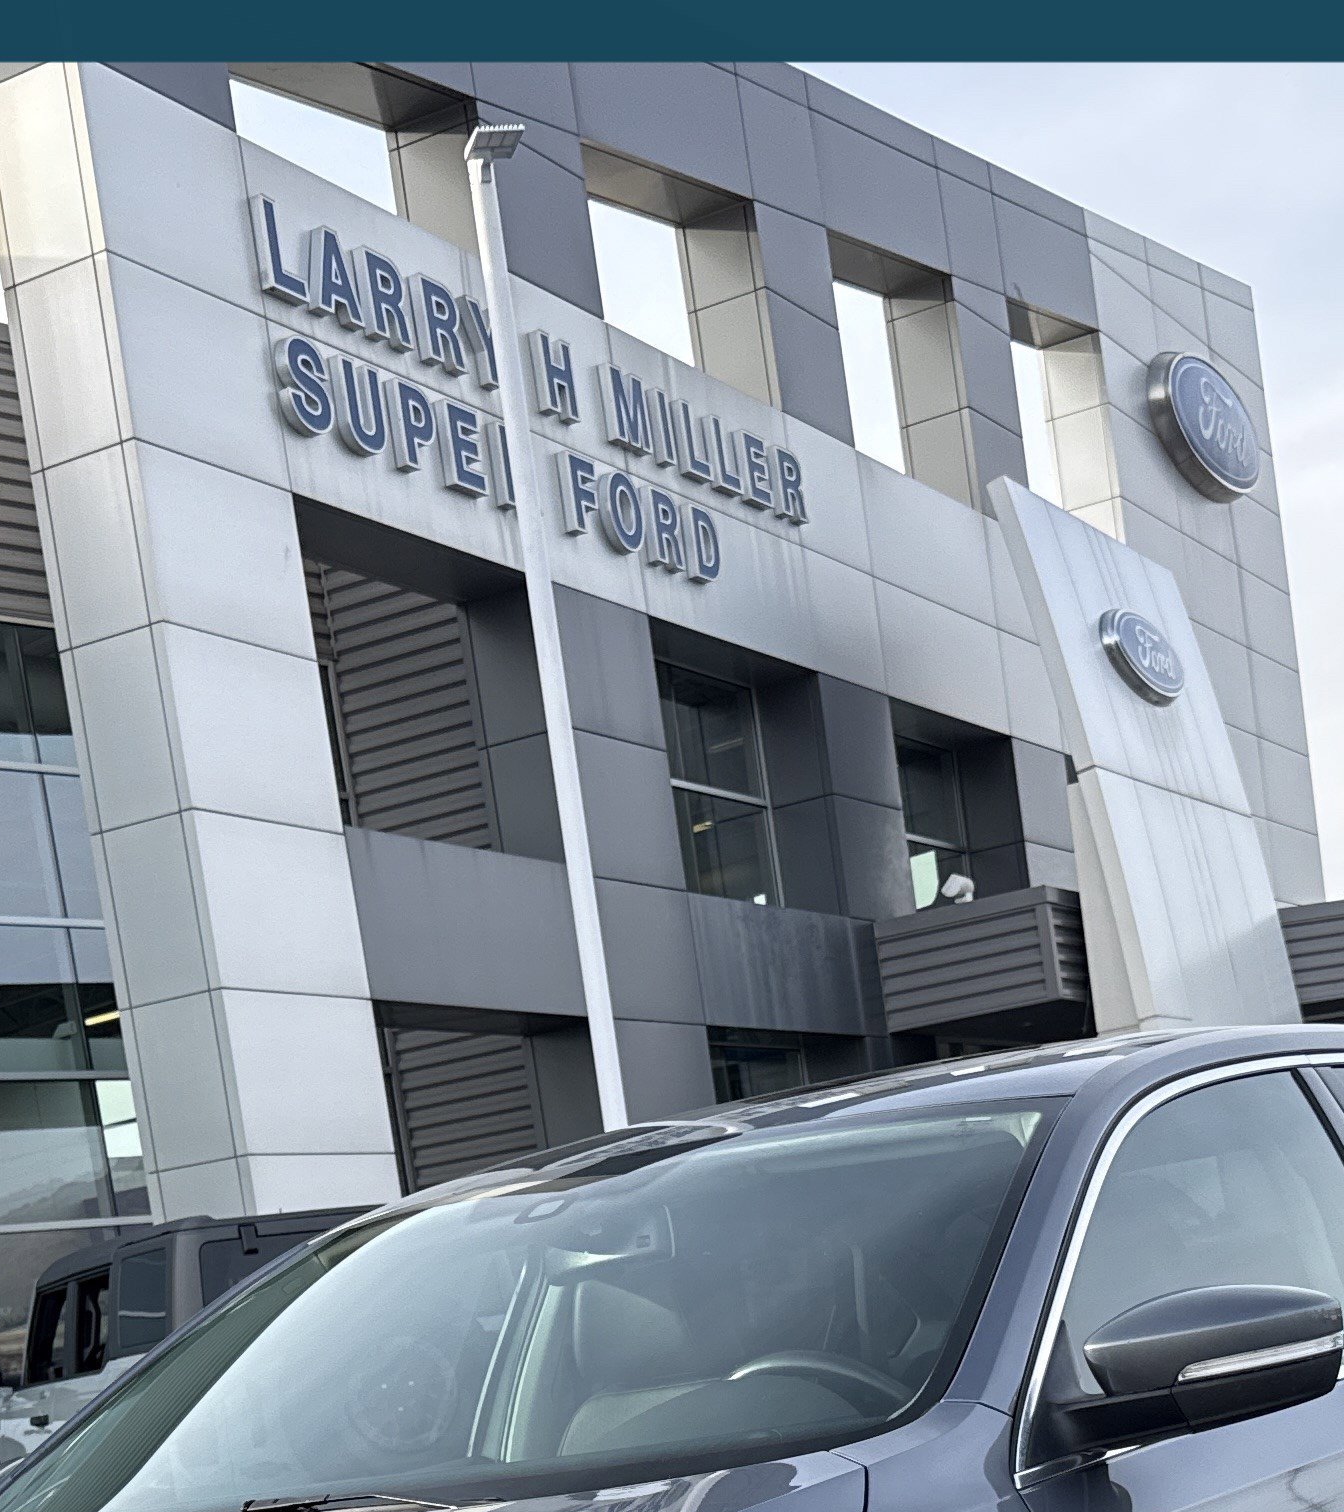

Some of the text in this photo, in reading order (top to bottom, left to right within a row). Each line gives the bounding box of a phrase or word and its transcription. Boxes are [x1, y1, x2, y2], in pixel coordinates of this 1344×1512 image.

[256, 194, 809, 525] LARRY H MILLER
[1198, 376, 1250, 468] Ford
[556, 449, 722, 584] FORD
[1135, 624, 1175, 681] Ford
